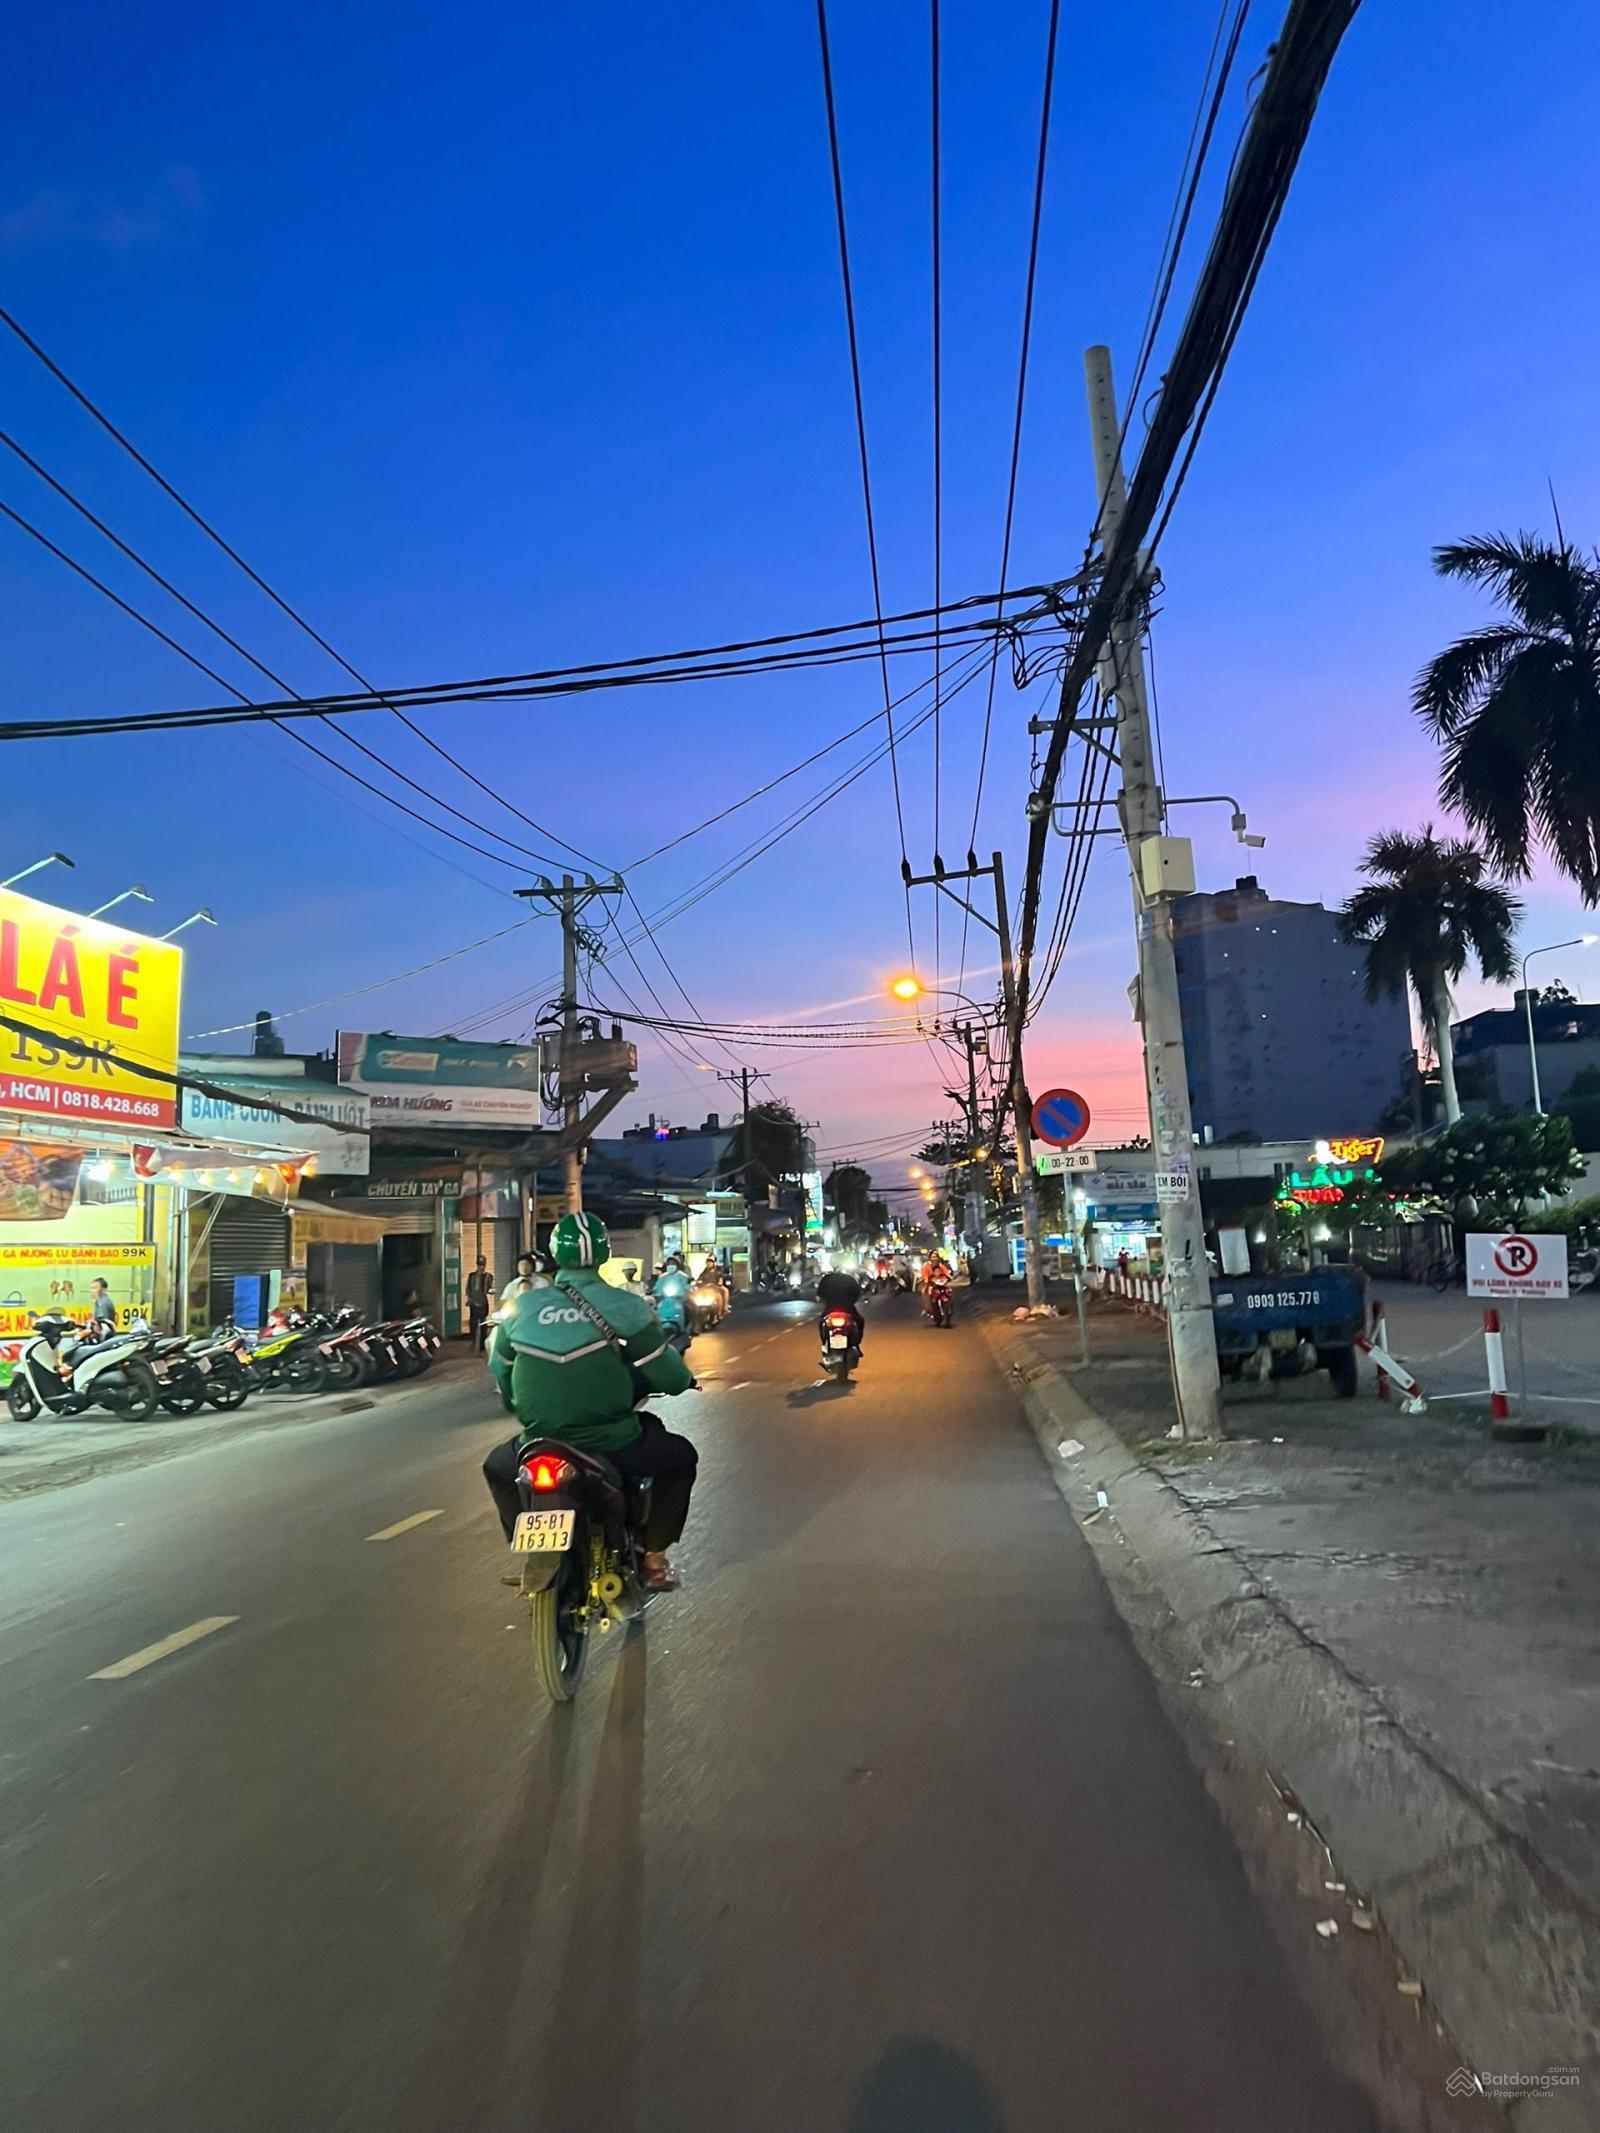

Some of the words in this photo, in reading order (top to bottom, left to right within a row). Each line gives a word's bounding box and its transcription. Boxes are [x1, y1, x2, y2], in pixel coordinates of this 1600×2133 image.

[0, 919, 86, 1018] LÁ
[107, 944, 141, 1030] É
[11, 1081, 50, 1102] HCM
[62, 1090, 160, 1118] 0818.428.668
[1331, 1139, 1375, 1163] Tiger
[122, 1248, 147, 1257] 99K
[1247, 1294, 1275, 1309] 0903
[519, 1531, 568, 1550] 163.13
